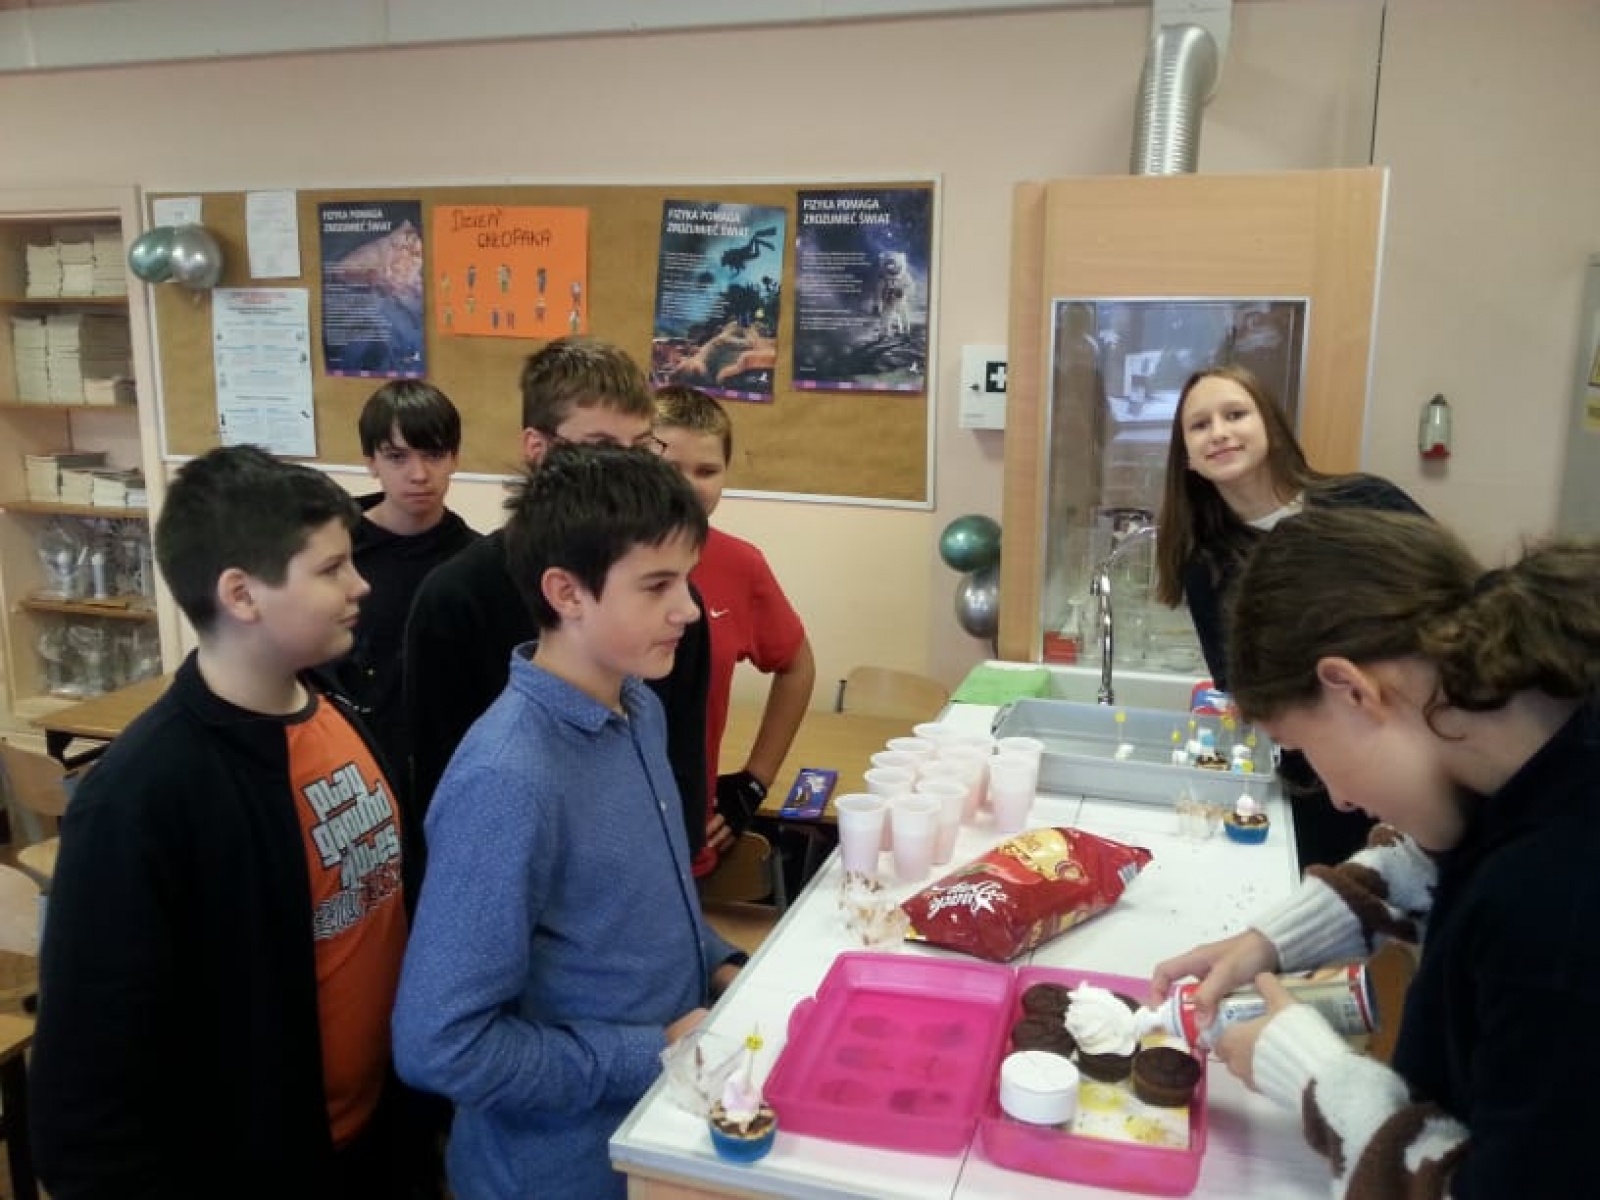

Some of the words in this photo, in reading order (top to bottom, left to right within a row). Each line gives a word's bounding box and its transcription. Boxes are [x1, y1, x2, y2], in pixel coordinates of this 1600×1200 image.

[803, 199, 835, 210] FIZYKA
[837, 198, 879, 209] POMAGA
[859, 211, 890, 224] ŚWIAT
